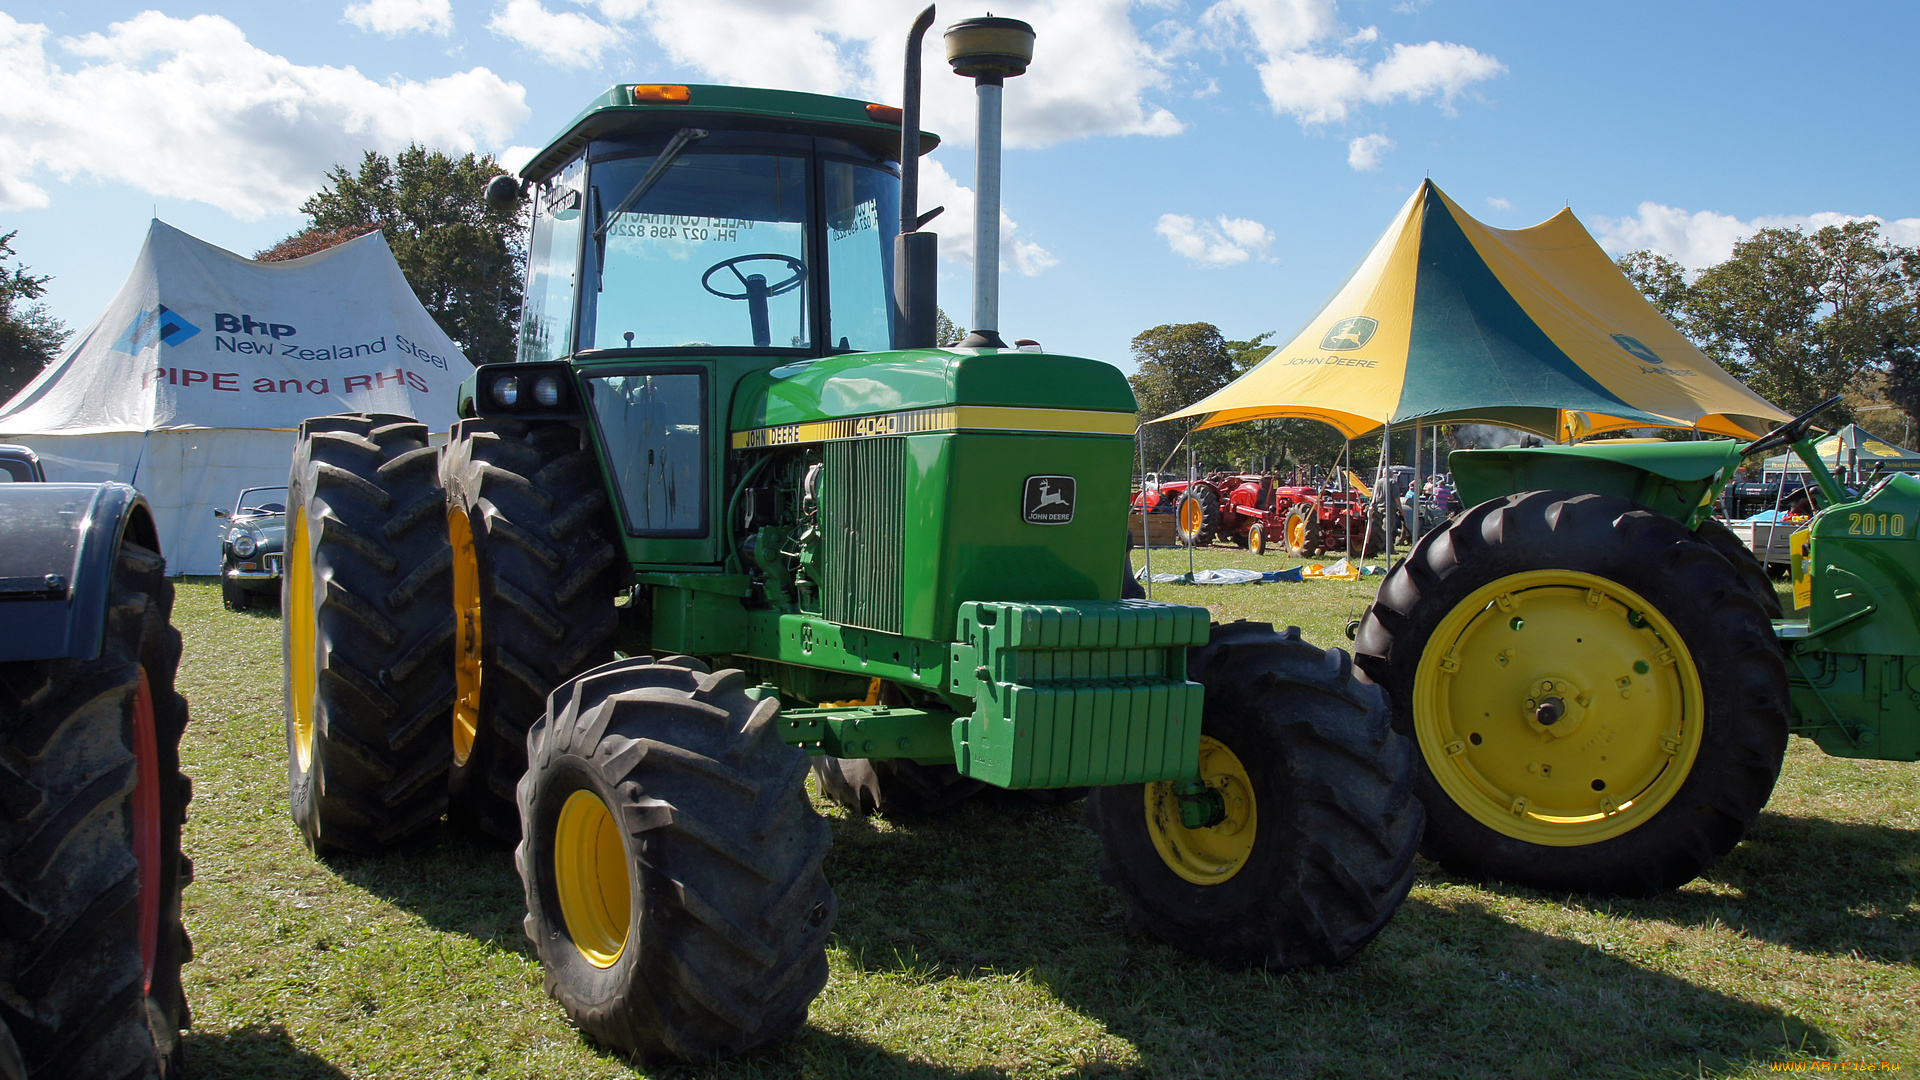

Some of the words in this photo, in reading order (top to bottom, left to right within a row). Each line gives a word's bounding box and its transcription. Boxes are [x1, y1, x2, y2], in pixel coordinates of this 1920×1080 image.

[216, 335, 274, 356] New
[281, 336, 388, 361] Zealand
[396, 334, 448, 372] Steel
[142, 367, 241, 392] PIPE
[252, 378, 330, 396] and
[344, 368, 429, 394] RHS
[745, 429, 766, 447] JOHN
[771, 426, 801, 445] DEERE
[856, 415, 898, 437] 4040
[1848, 512, 1905, 537] 2010
